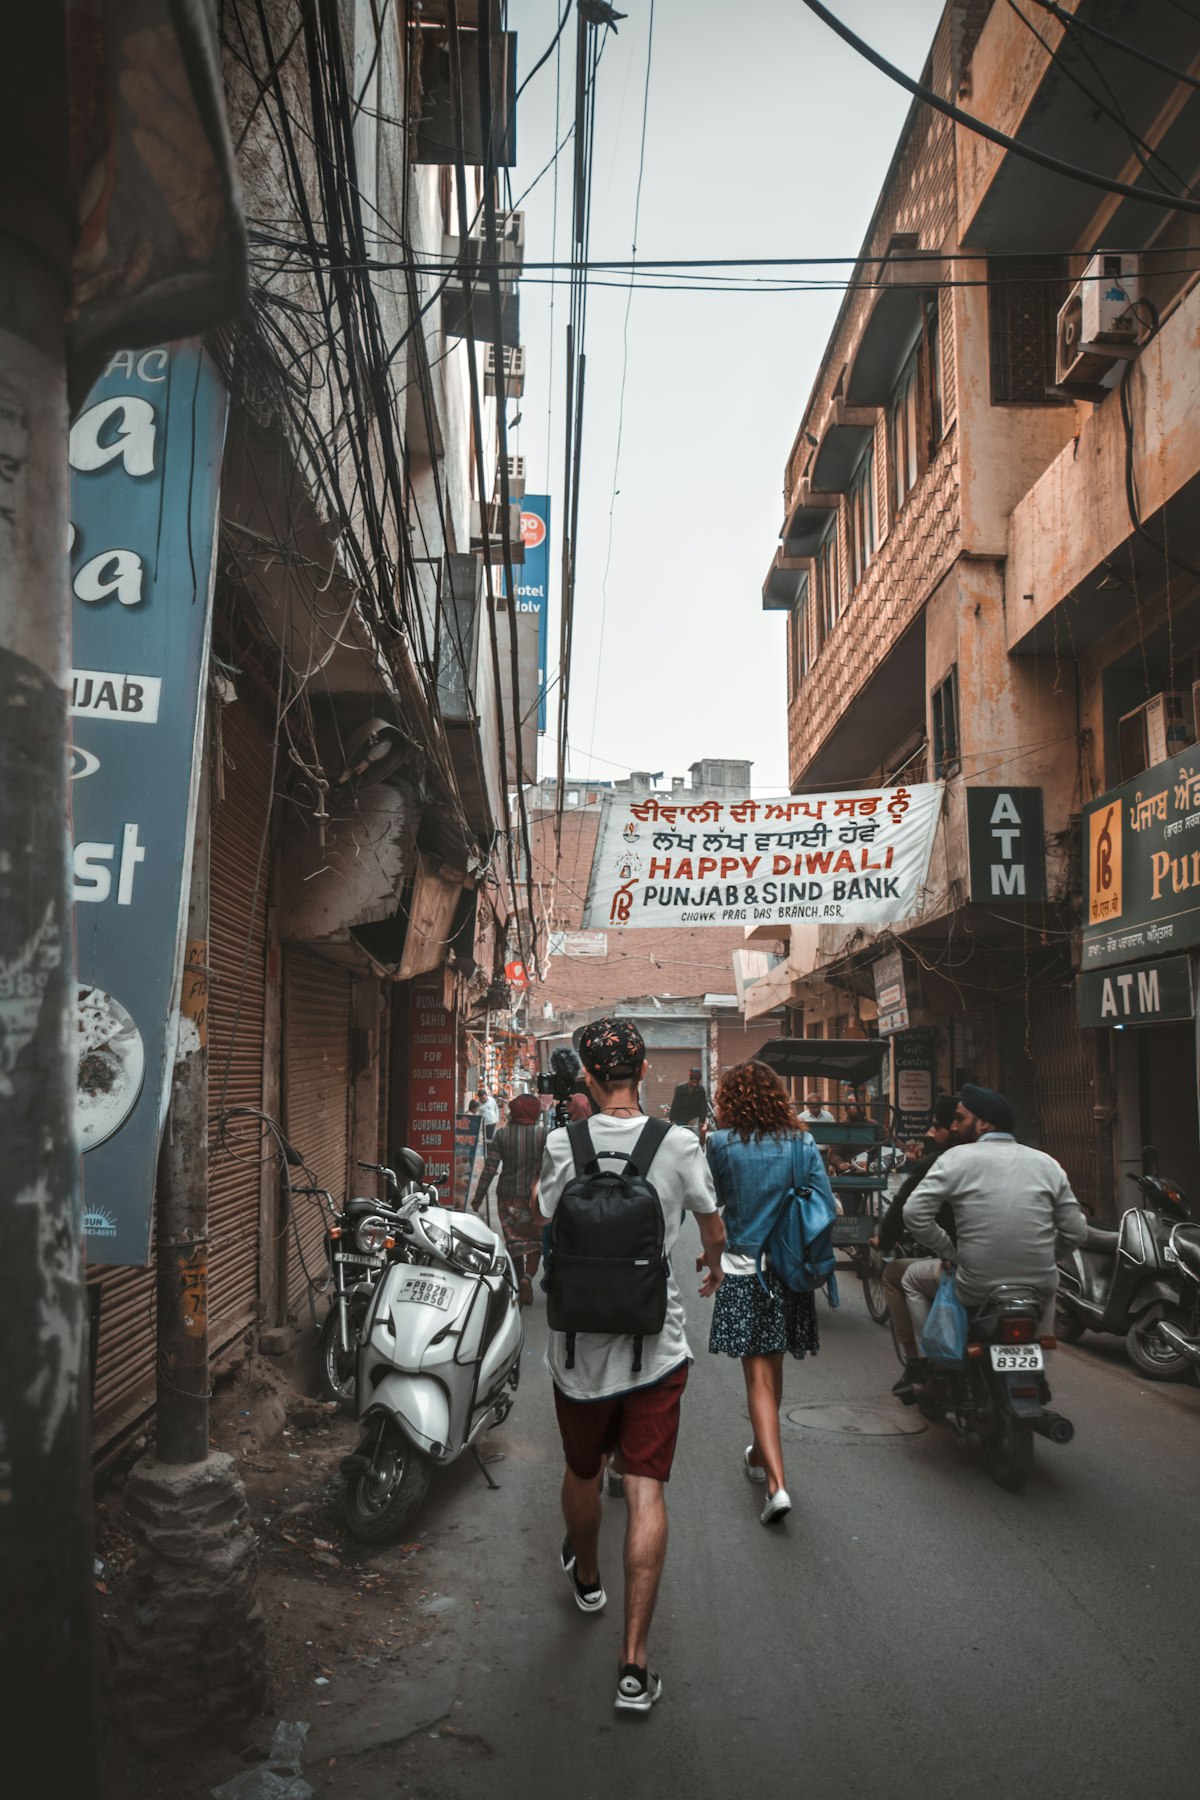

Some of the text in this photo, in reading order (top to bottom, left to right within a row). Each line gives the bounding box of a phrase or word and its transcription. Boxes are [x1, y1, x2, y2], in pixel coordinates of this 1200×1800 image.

[630, 788, 912, 824] ਦੀਵਾਲੀ ਦੀ ਆਪ ਸਭ ਨੂੰ
[1130, 791, 1169, 832] ਪੰਜਾਬ
[653, 826, 697, 852] ਲੱਖ
[703, 826, 748, 852] ਲੱਖ
[839, 817, 880, 844] ਹੋਵੇ
[990, 793, 1026, 896] ATM
[649, 847, 894, 880] HAPPY DIWALI
[643, 877, 900, 906] PUNJAB & SIND BANK
[681, 912, 716, 921] CHOWK
[722, 909, 747, 920] PRAG
[753, 908, 772, 919] DAS
[1101, 969, 1160, 1018] ATM
[424, 1052, 442, 1062] FOR
[433, 1069, 452, 1079] TEMPLE
[416, 1102, 448, 1112] ALL OTHER
[412, 1120, 451, 1132] GURDWARA
[421, 1134, 442, 1146] SAHIB
[84, 1218, 103, 1226] SUN
[410, 1291, 444, 1306] Z3850
[997, 1356, 1038, 1368] 8328
